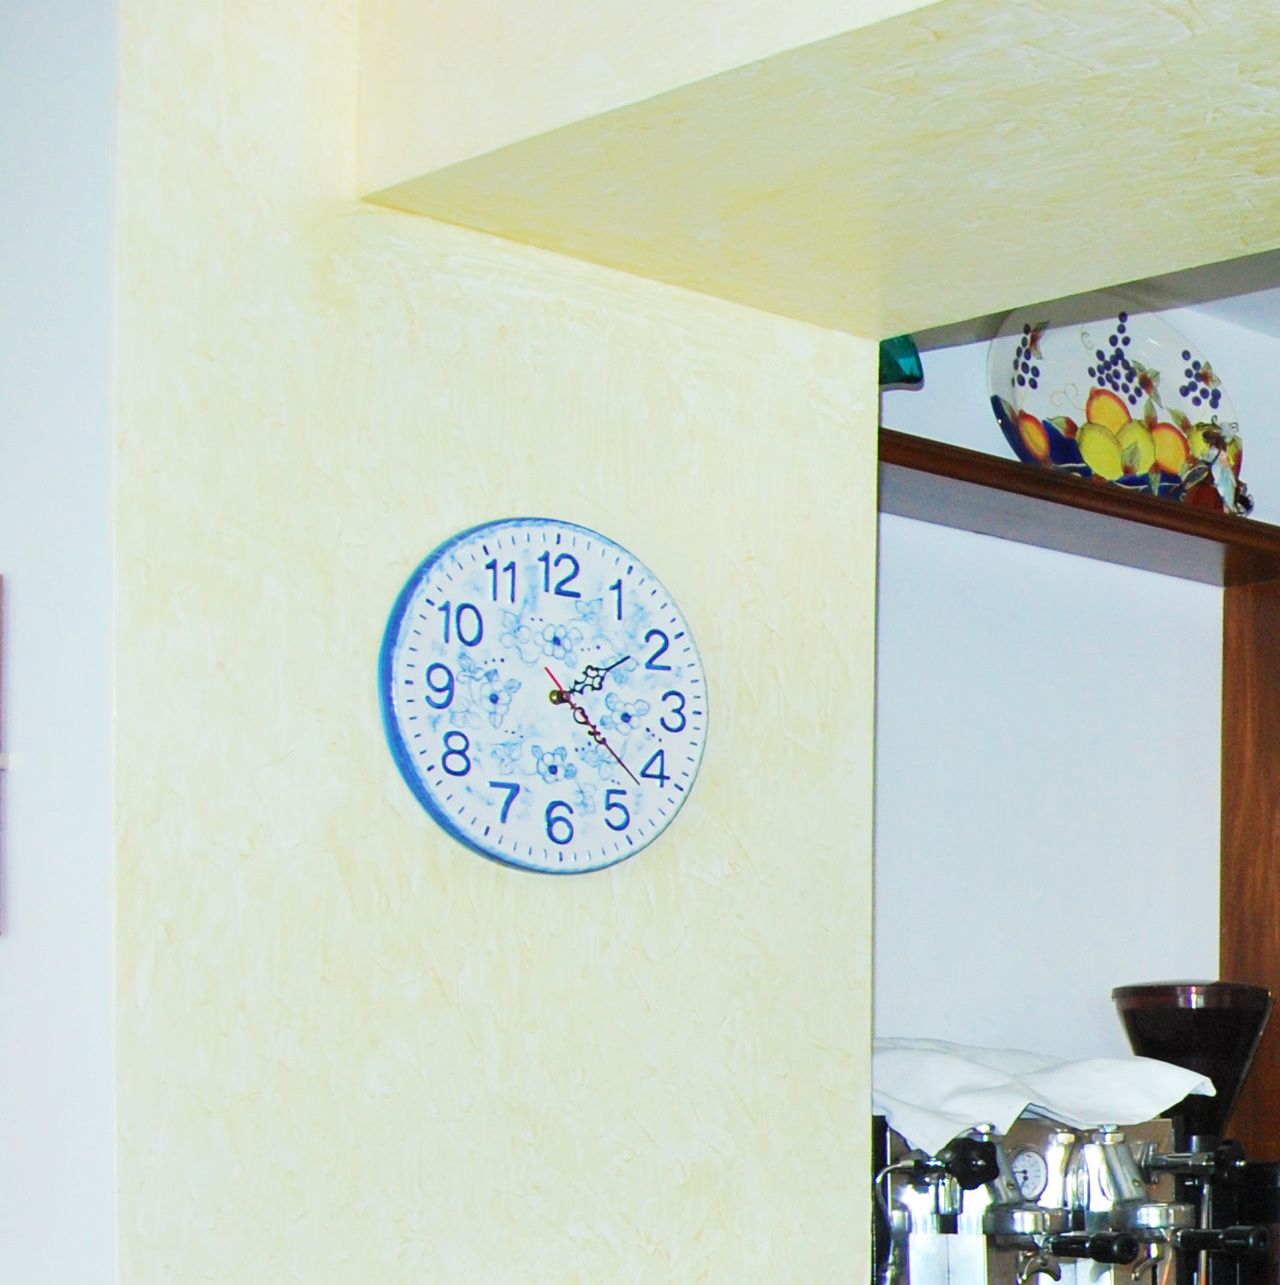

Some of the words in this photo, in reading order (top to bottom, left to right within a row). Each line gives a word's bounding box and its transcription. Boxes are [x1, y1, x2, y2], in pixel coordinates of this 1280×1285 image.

[485, 559, 516, 603] 11
[538, 551, 581, 598] 12
[609, 579, 622, 620] 1
[438, 601, 483, 647] 10
[644, 629, 672, 671] 2
[425, 662, 454, 709] 9
[660, 691, 686, 732] 3
[442, 731, 471, 777] 8
[640, 750, 670, 788] 4
[488, 781, 520, 823] 7
[545, 801, 574, 845] 6
[605, 789, 630, 831] 5
